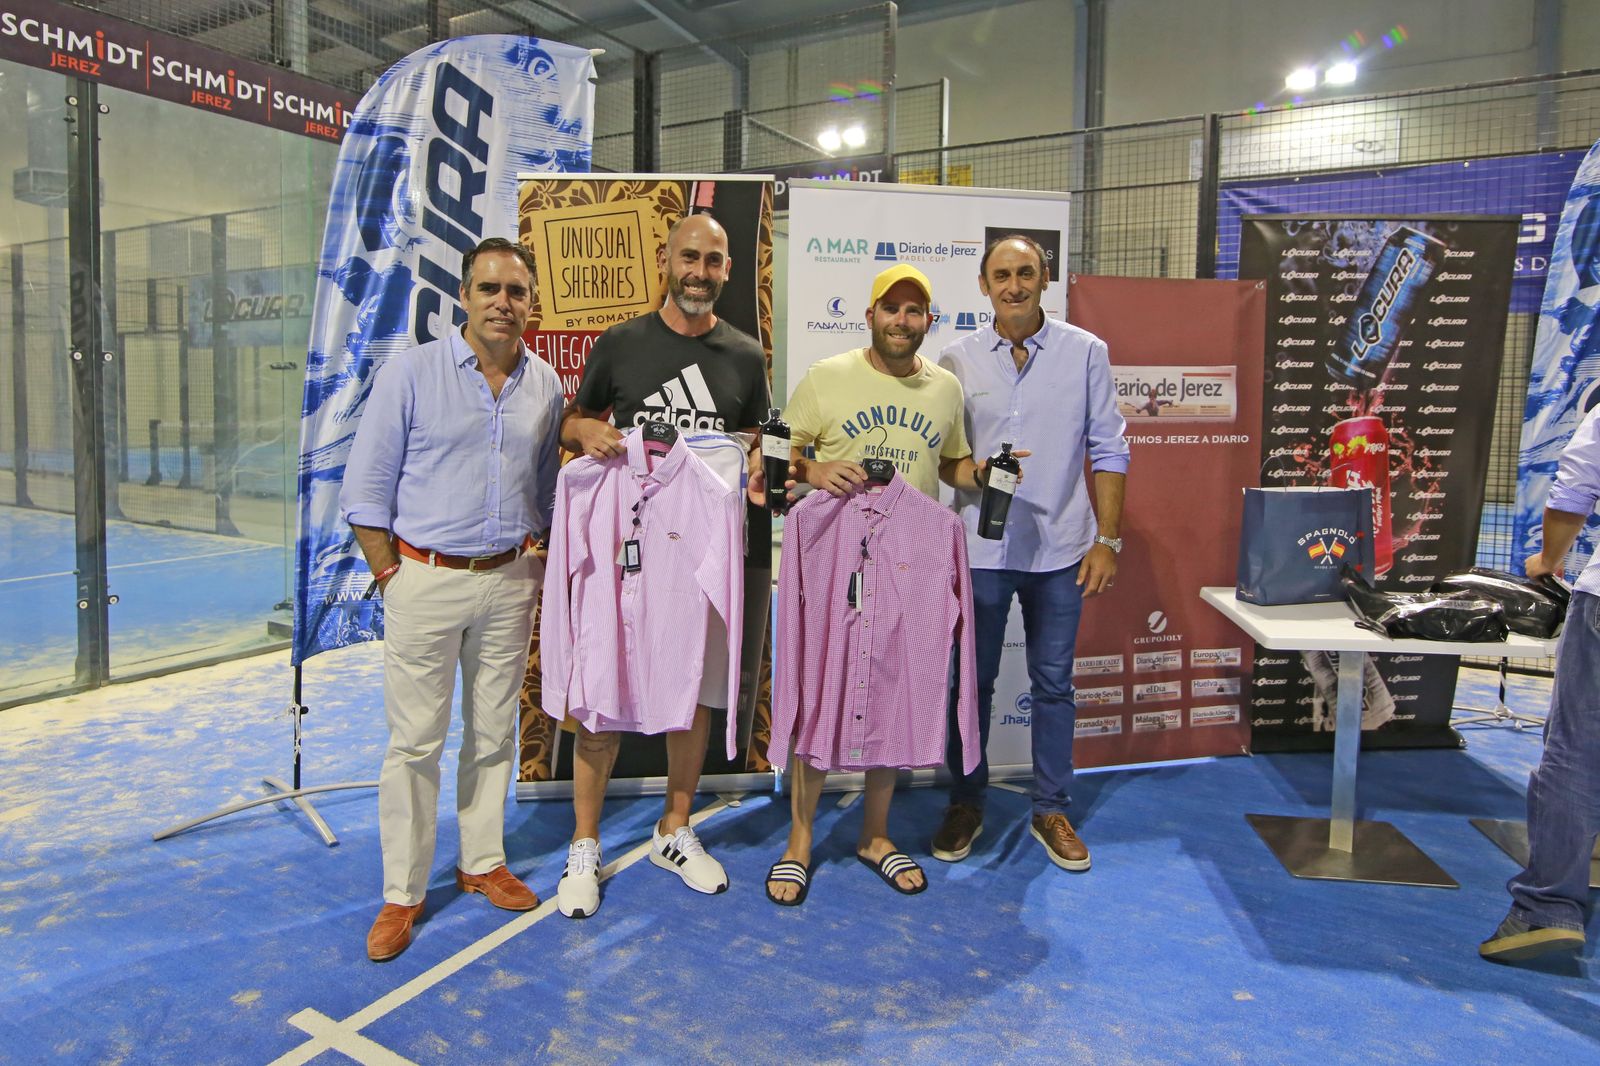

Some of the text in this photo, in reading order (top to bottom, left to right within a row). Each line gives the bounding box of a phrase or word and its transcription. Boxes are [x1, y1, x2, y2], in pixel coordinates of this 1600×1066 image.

[1, 12, 143, 70] SCHMiDT
[50, 52, 101, 76] JEREZ
[151, 55, 267, 104] SCHMiDT
[190, 90, 233, 111] JEREZ
[272, 90, 354, 130] SCHMiD
[304, 121, 339, 139] JEREZ
[560, 226, 636, 260] UNUSUAL
[827, 238, 869, 255] MAR
[898, 242, 977, 258] Diario de Jerez
[899, 254, 928, 262] PADEL
[560, 264, 636, 300] SHERRIES
[1351, 247, 1416, 361] LOCURA
[566, 310, 640, 328] BY ROMATE
[807, 320, 866, 332] FANAUTIC
[1115, 378, 1223, 402] iario de Jerez
[632, 405, 725, 432] adidas
[840, 405, 941, 449] HONOLULU
[1122, 434, 1249, 444] TIMOS JEREZ A DIARIO
[864, 444, 919, 462] US STATE OF
[1296, 527, 1355, 546] SPAGNOLO
